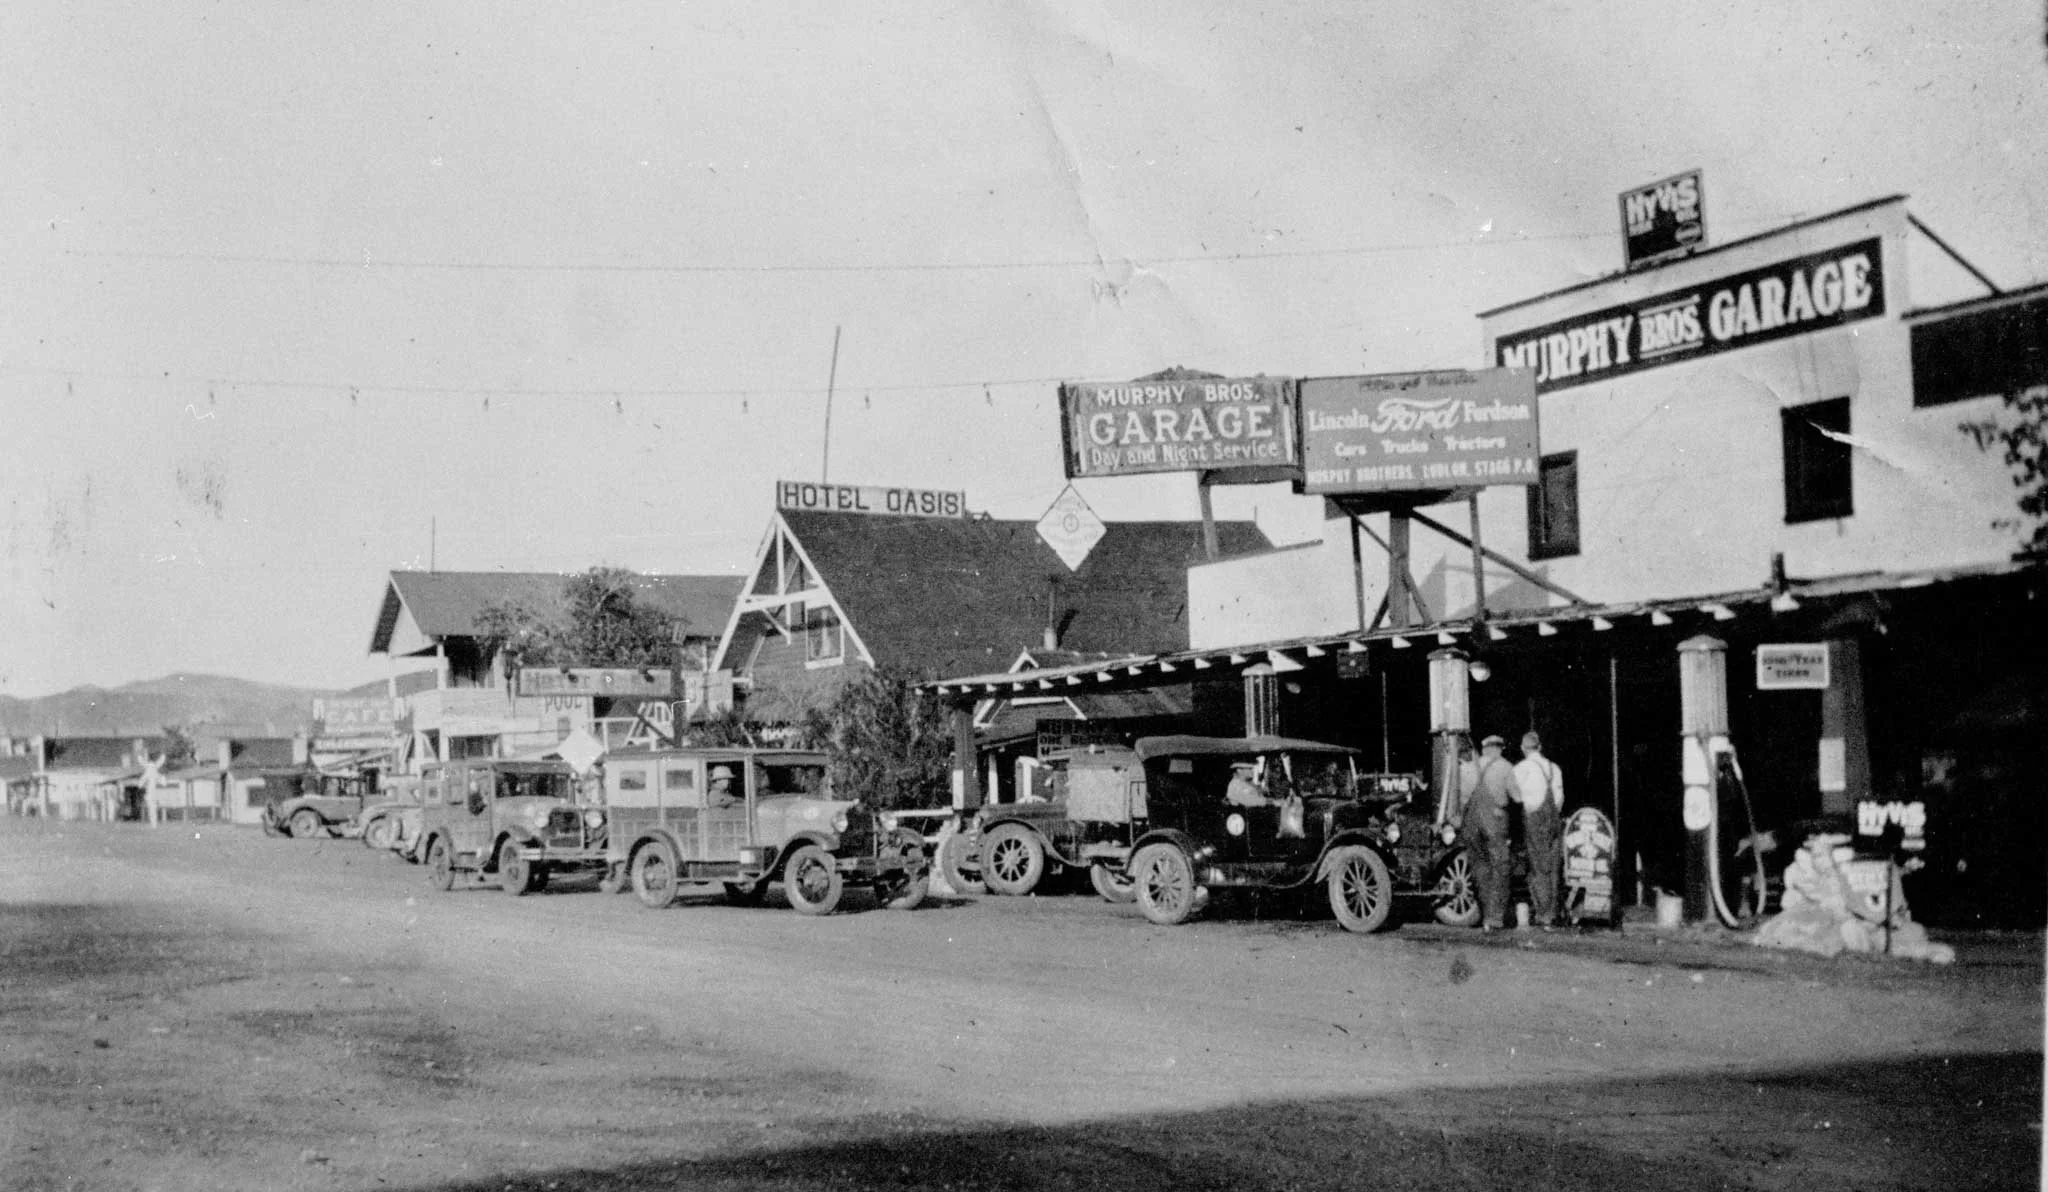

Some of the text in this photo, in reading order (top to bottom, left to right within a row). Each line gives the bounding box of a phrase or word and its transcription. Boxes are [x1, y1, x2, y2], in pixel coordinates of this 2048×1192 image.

[1502, 316, 1635, 384] MURPHY
[1708, 253, 1874, 341] GARAGE
[1097, 383, 1262, 407] MURPHY BROS.
[1089, 404, 1275, 446] GARAGE
[1308, 409, 1370, 432] Lincoln
[1370, 397, 1462, 434] Ford
[1091, 439, 1280, 470] Day and Night Service
[1334, 434, 1507, 457] Cars Trucks Tractors
[783, 484, 958, 515] HOTEL OASIS
